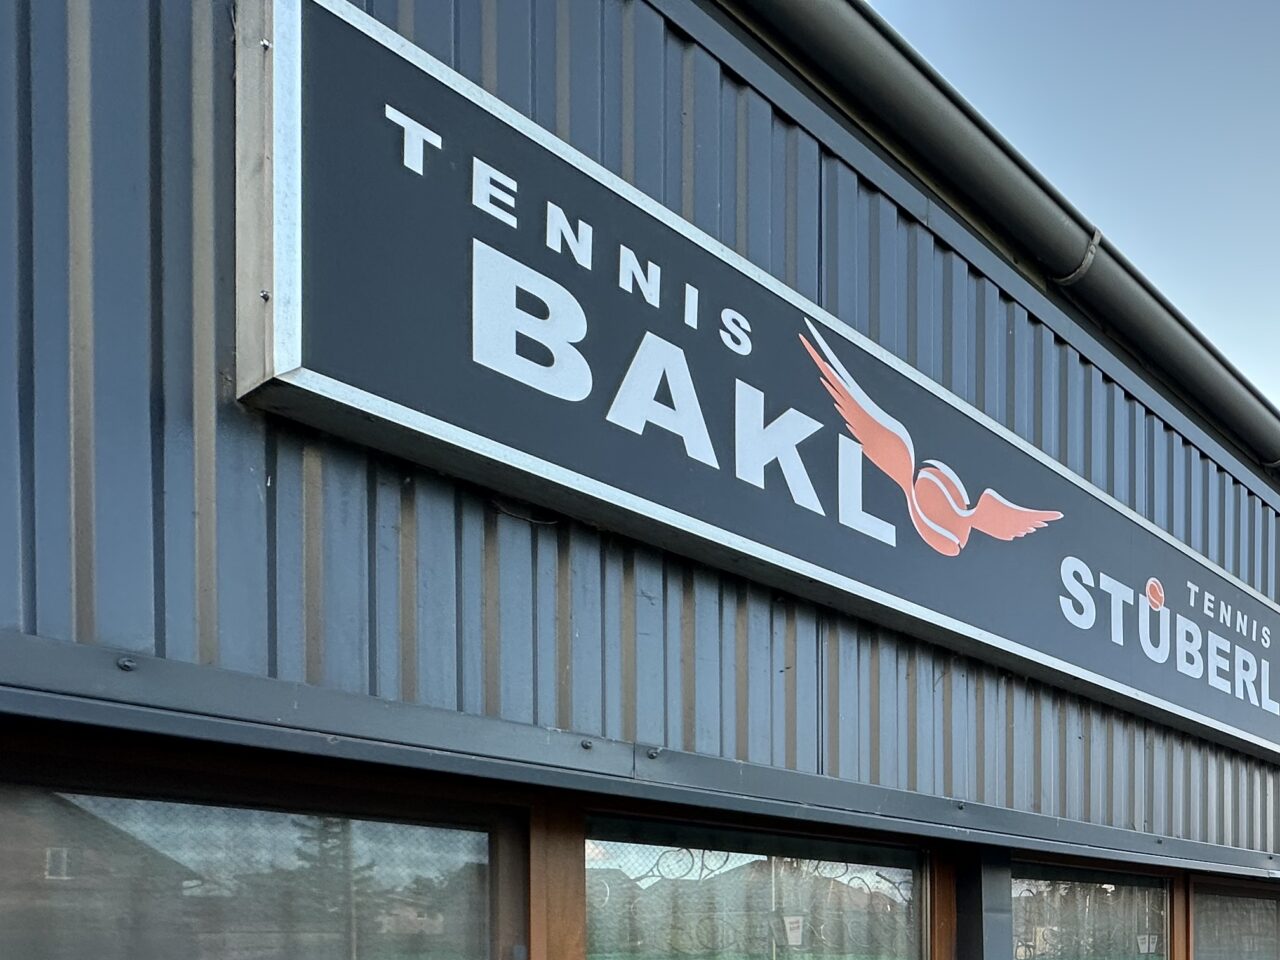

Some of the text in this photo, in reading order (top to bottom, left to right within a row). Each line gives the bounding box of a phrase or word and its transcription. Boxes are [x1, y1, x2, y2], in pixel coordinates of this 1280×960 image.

[385, 103, 753, 357] TENNIS
[472, 237, 897, 547] BAKL
[1186, 580, 1272, 648] TENNIS
